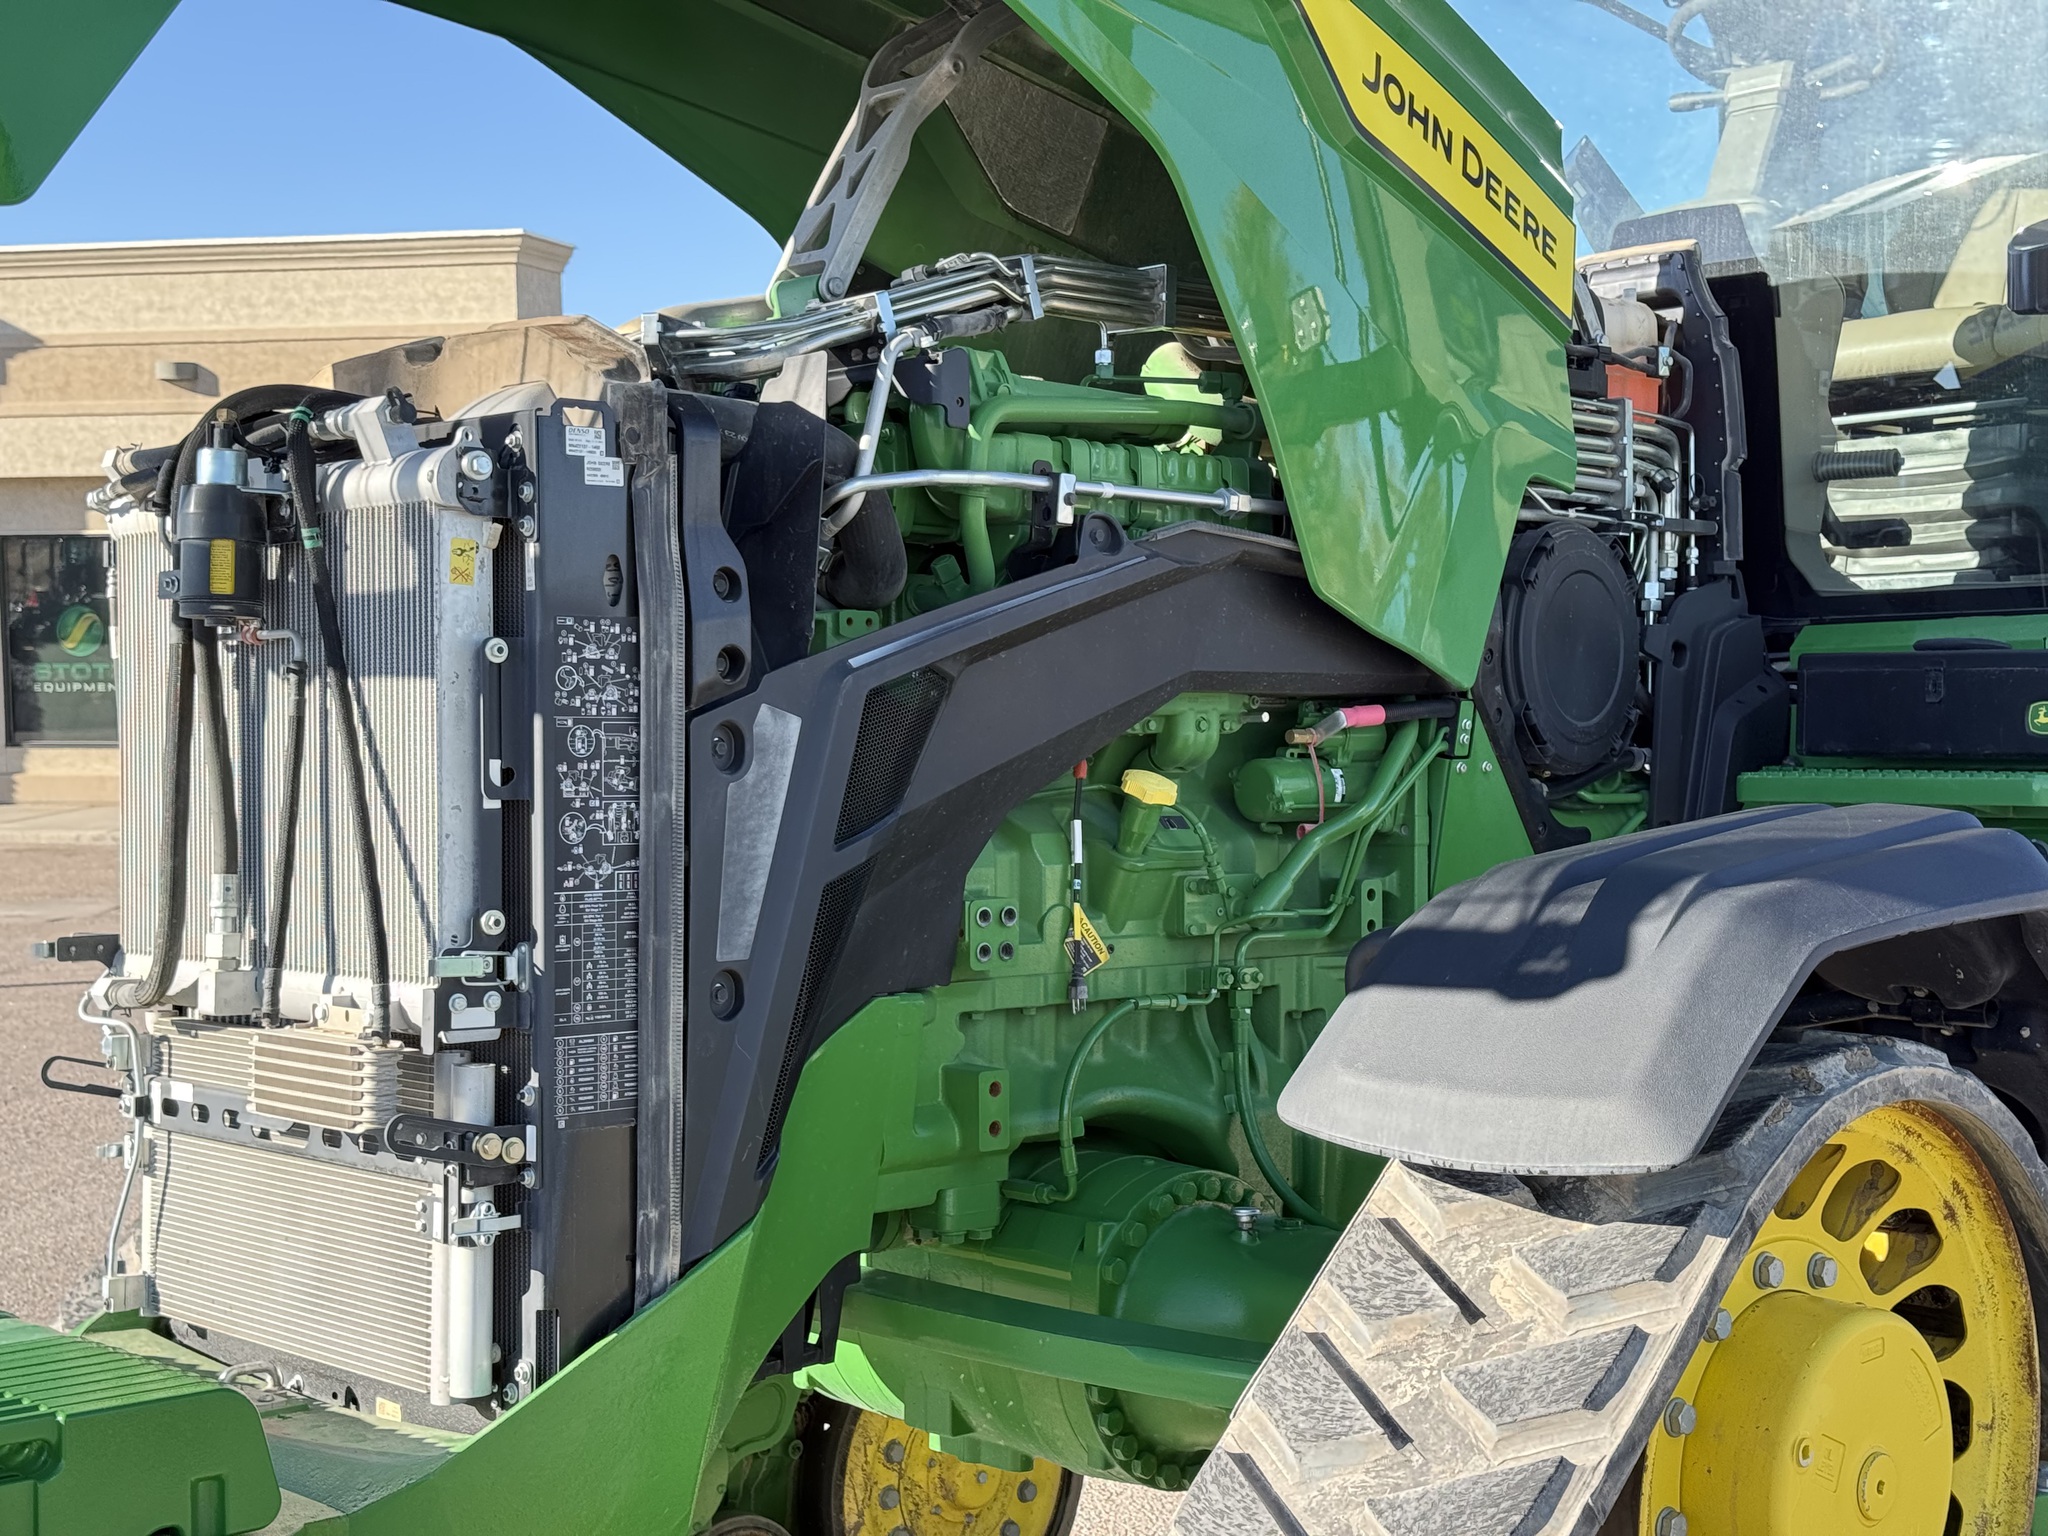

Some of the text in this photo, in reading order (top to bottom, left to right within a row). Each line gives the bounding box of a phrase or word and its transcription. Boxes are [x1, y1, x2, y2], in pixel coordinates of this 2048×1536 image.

[1362, 52, 1557, 270] JOHN DEERE
[34, 662, 112, 681] STOT
[33, 681, 116, 693] EQUIPMEN
[1081, 922, 1106, 955] CAUTION
